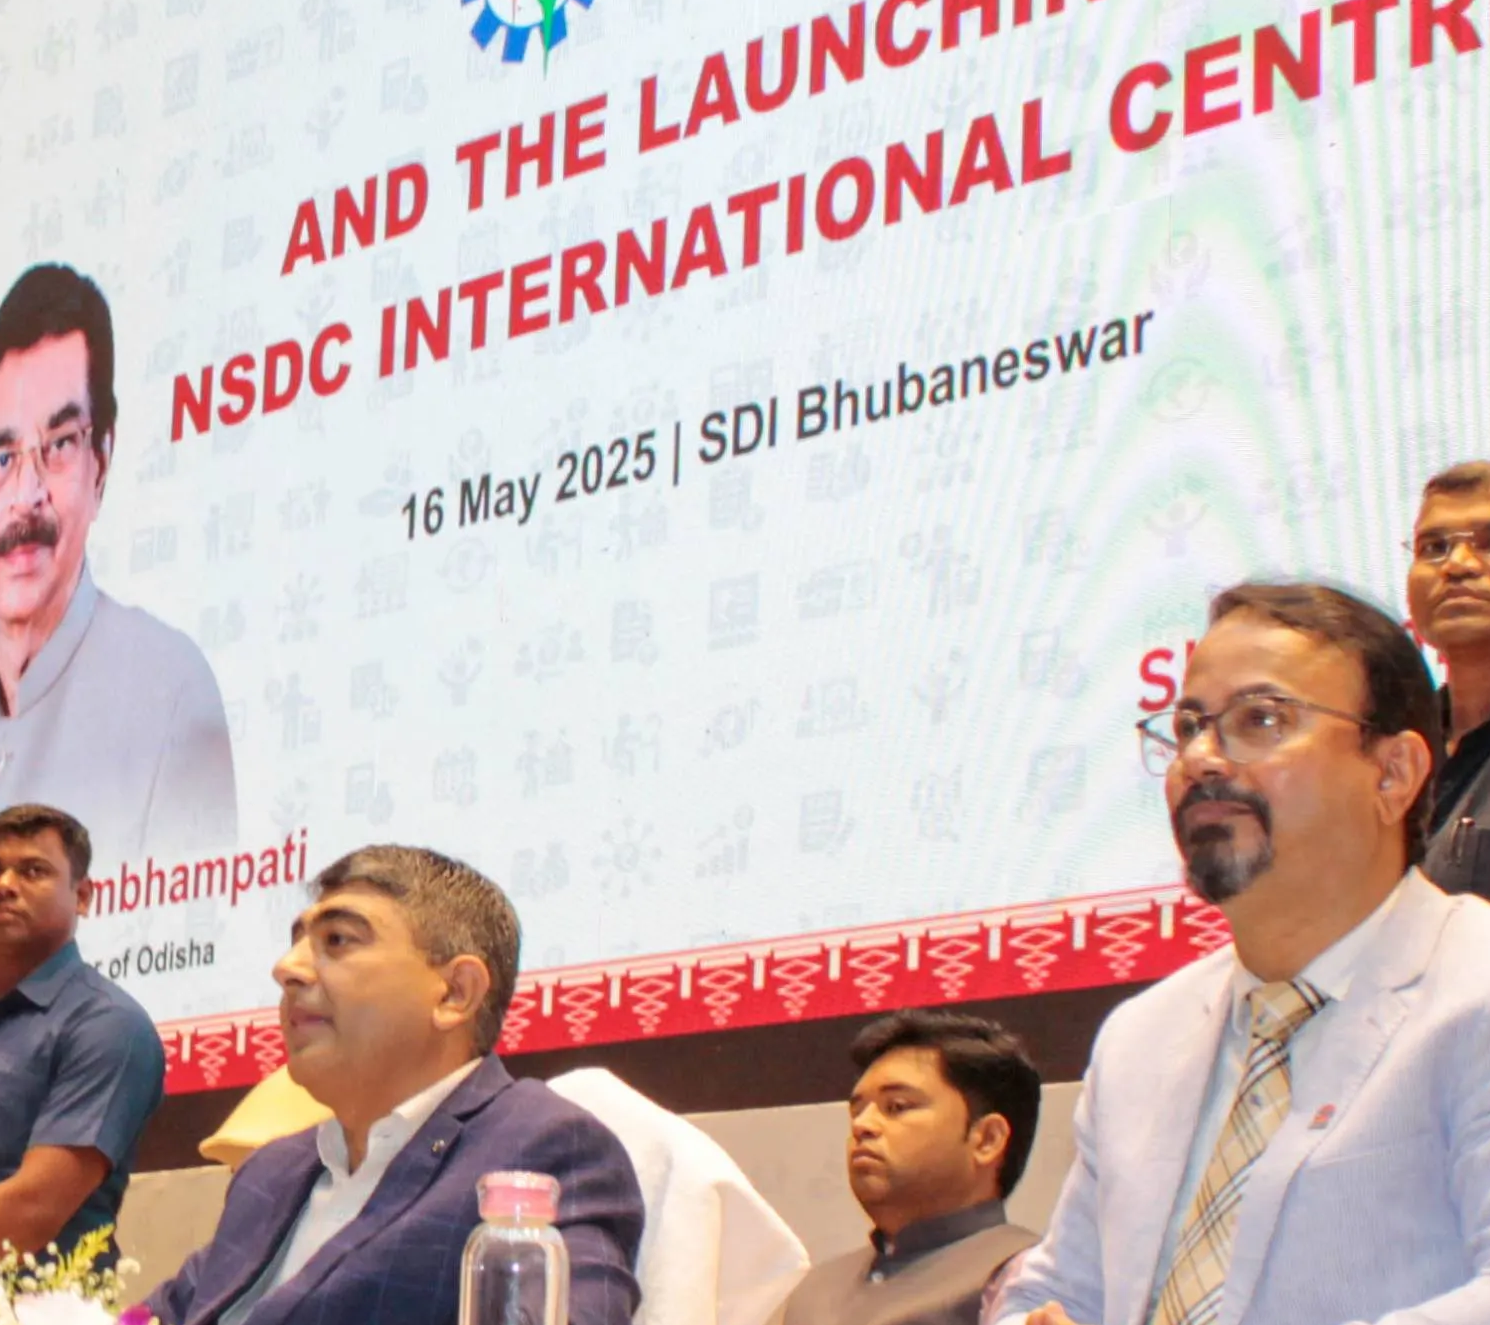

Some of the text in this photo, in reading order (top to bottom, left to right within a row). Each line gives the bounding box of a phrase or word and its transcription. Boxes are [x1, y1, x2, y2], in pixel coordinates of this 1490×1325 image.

[170, 323, 353, 443] NSDC
[380, 99, 1073, 378] INTERNATIONAL
[282, 163, 429, 276] AND
[456, 95, 608, 211] THE
[403, 488, 444, 540] 16
[458, 473, 541, 526] May
[555, 430, 656, 502] 2025
[698, 398, 779, 464] SDI
[796, 311, 1155, 441] Bhubaneswar
[92, 828, 307, 917] mbhampati
[109, 949, 131, 979] of
[137, 939, 215, 976] Odisha
